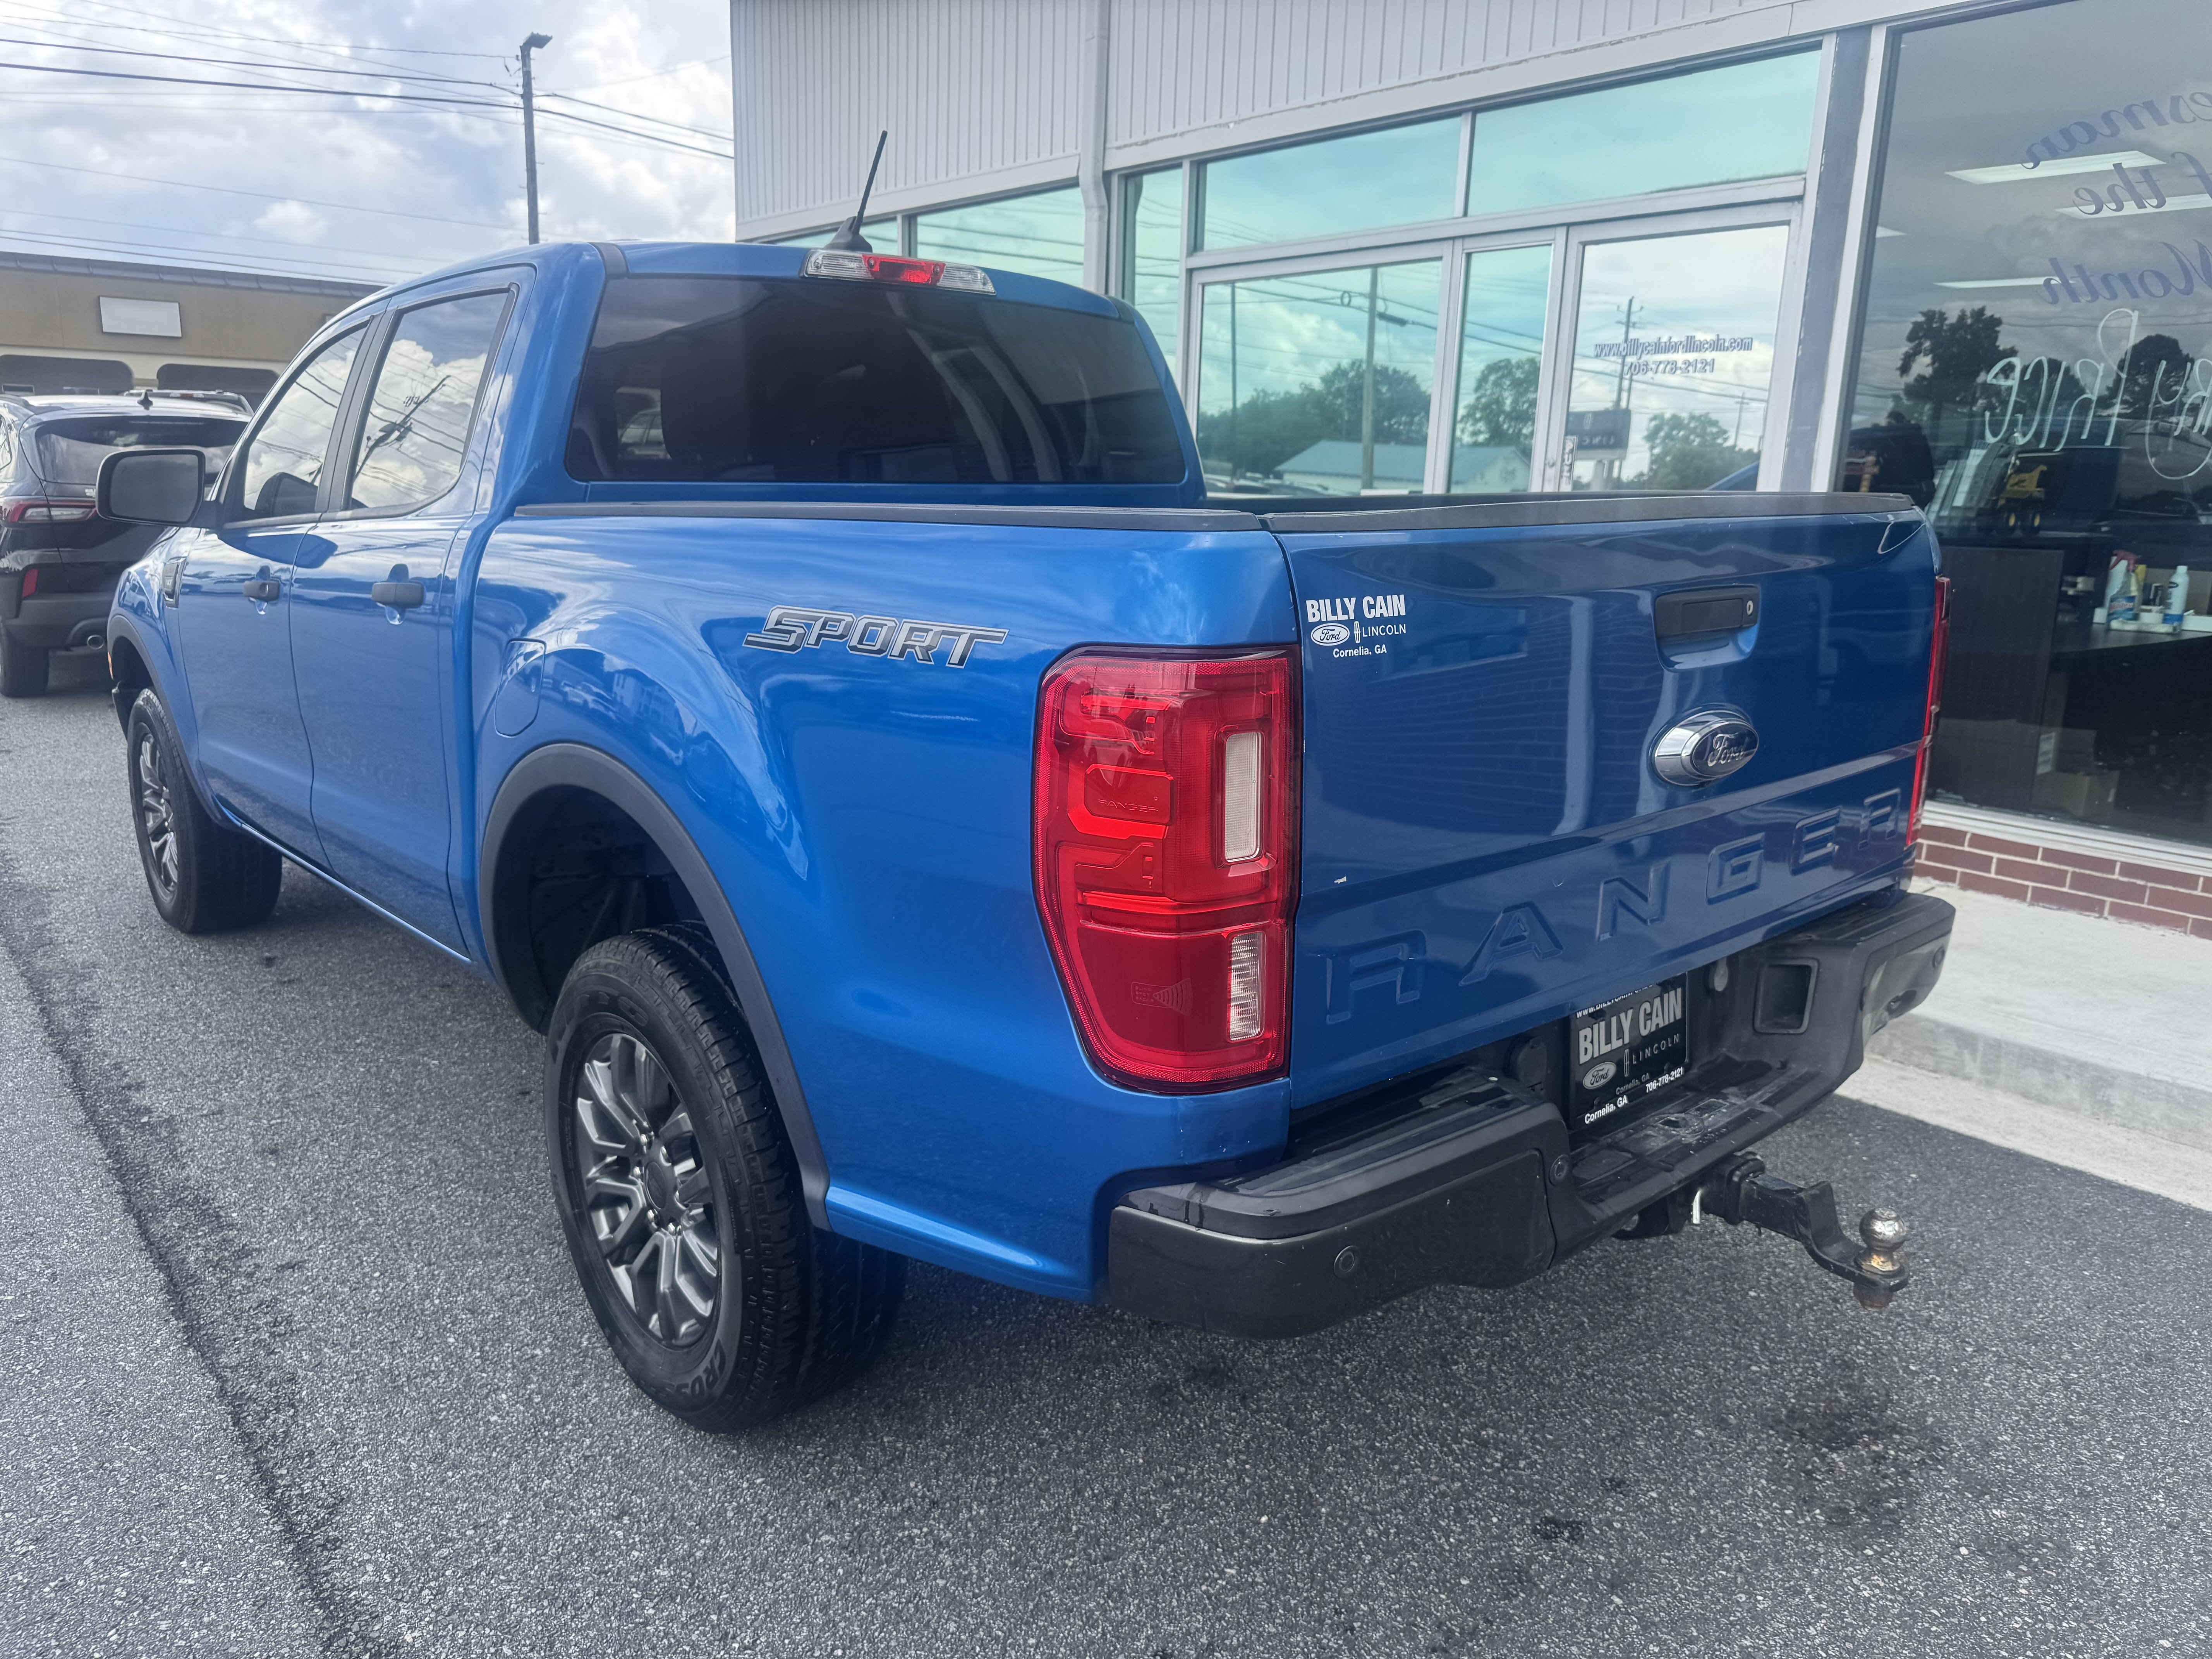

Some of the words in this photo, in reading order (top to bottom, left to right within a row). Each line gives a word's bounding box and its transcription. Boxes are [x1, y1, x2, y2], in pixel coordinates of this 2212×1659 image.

[1594, 334, 1753, 360] www.billycainfordlincoln.com
[1624, 358, 1715, 376] 706-778-2121
[1306, 598, 1356, 622] BILLY
[1363, 594, 1406, 618] CAIN
[742, 605, 1010, 669] SPORT
[1362, 623, 1406, 637] LINCOLN
[1374, 644, 1387, 654] GA
[1326, 788, 1901, 1025] RANGER
[1579, 1009, 1633, 1064] BILLY
[1639, 988, 1681, 1036] CAIN
[1632, 1033, 1680, 1064] LINCOLN
[1617, 1095, 1628, 1108] GA
[1646, 1066, 1683, 1093] 706-778-2121
[1641, 1072, 1650, 1082] GA
